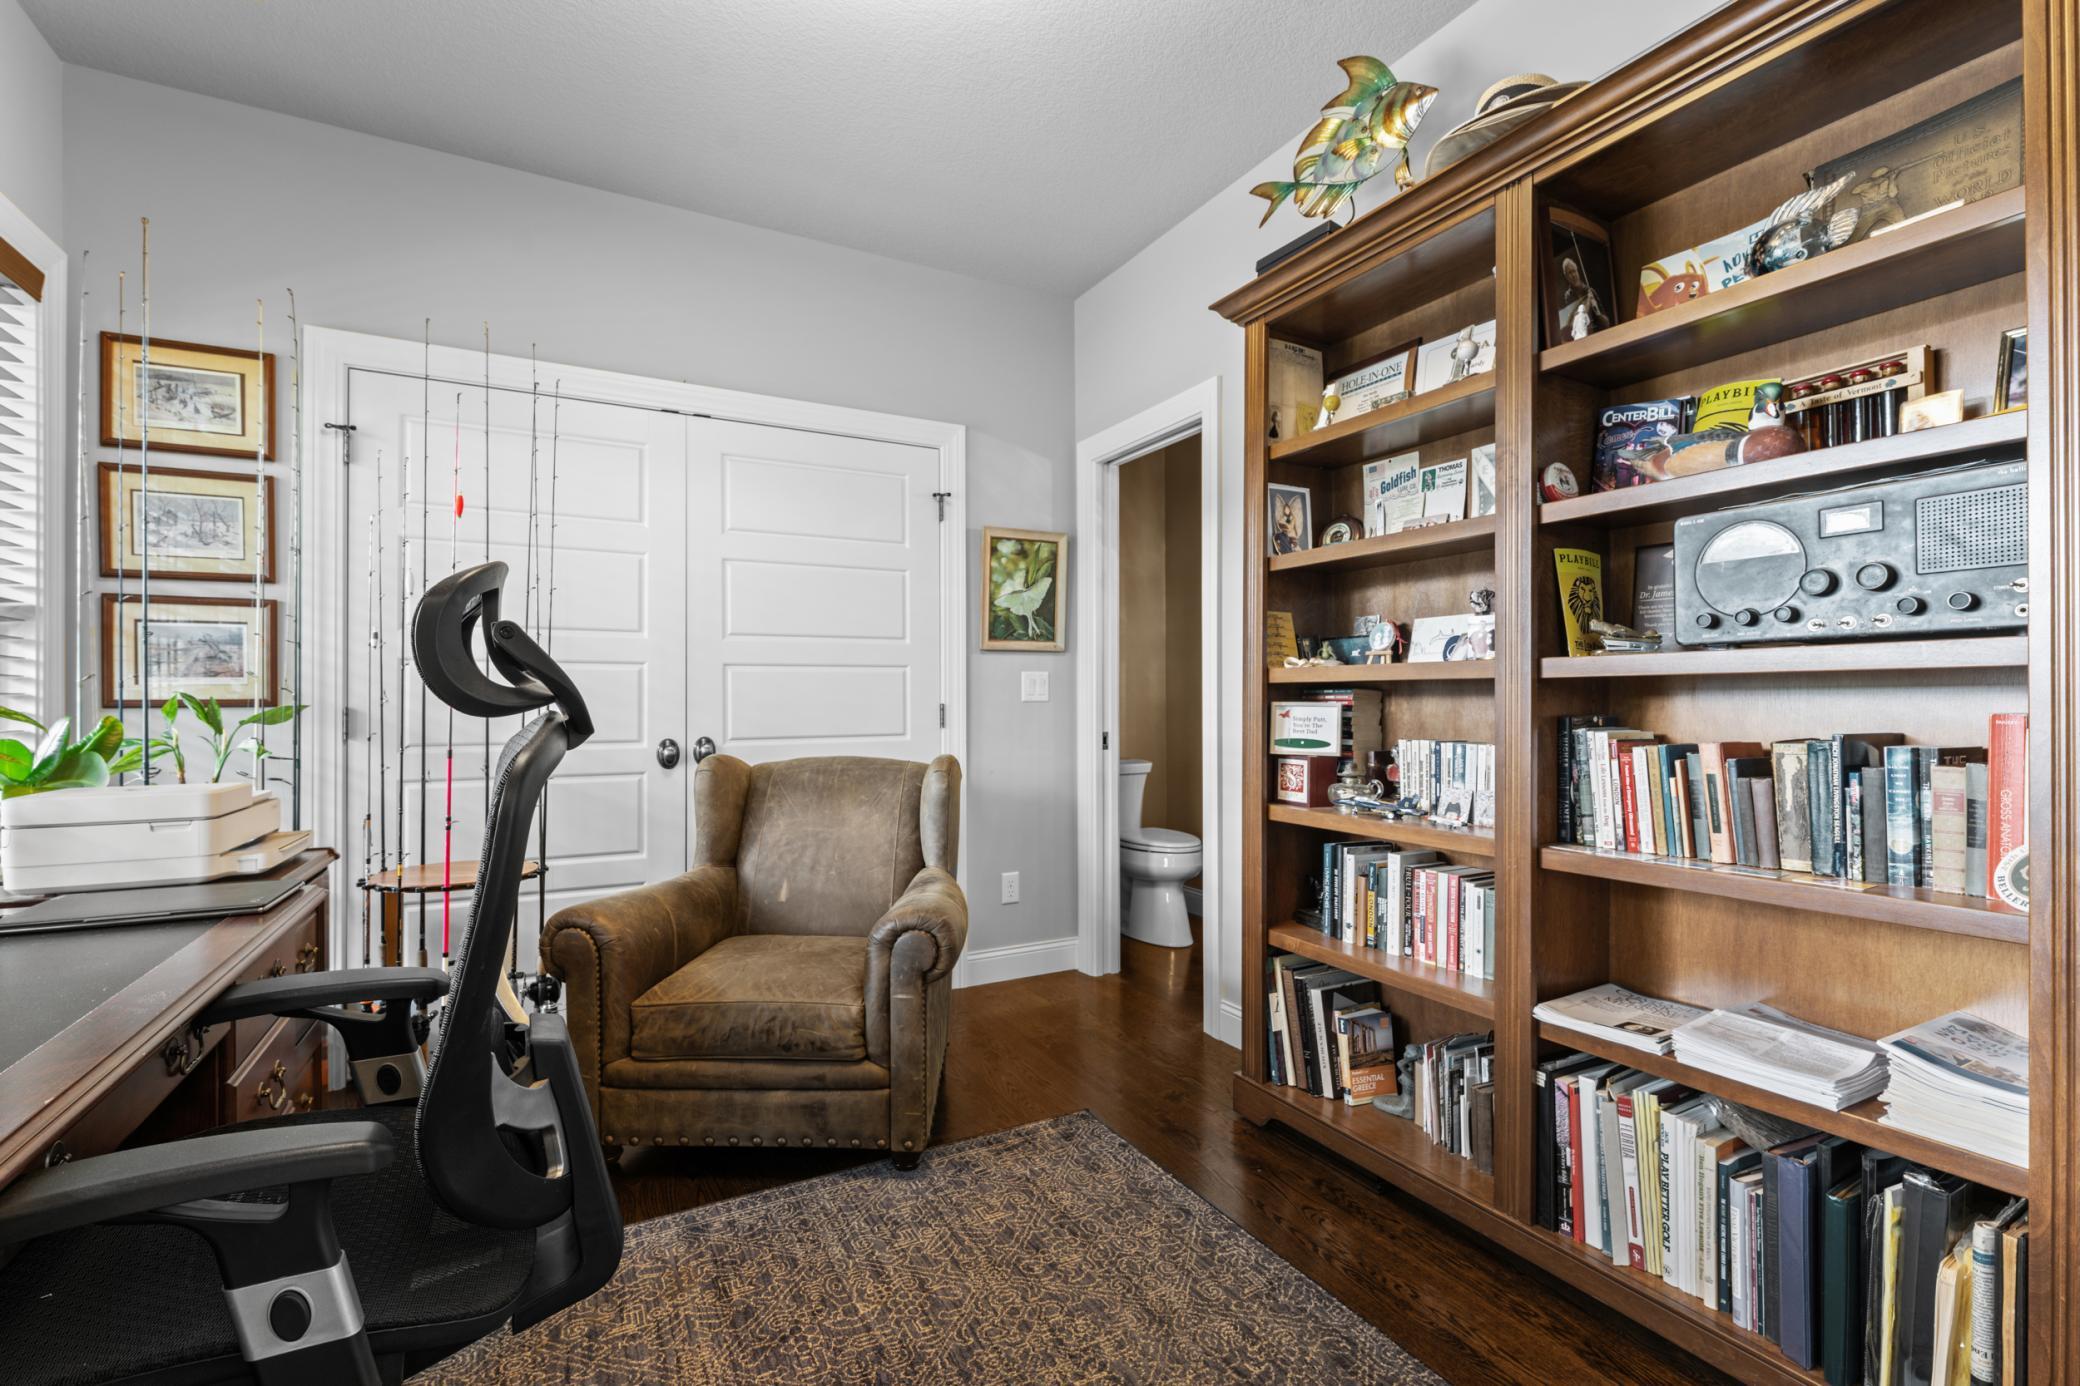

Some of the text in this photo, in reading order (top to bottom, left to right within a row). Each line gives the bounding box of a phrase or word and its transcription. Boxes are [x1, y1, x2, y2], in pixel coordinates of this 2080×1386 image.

[1934, 128, 2011, 168] Official
[1933, 143, 2013, 184] Pictures
[1341, 361, 1403, 391] HOLE-IN-ONE
[1700, 386, 1760, 405] PLAYBI
[1810, 395, 1831, 405] Taste
[1834, 391, 1843, 399] of
[1847, 383, 1882, 395] Vermont
[1380, 465, 1417, 494] Goldfish
[1437, 462, 1463, 472] THOMAS
[1559, 554, 1600, 569] PLAYBILL
[1639, 590, 1674, 600] Dr. Jame
[1832, 758, 1840, 786] JONATHAN
[1612, 779, 1620, 805] LONDON
[1833, 787, 1841, 819] LIVINGSTON
[1999, 791, 2013, 820] GROSS
[1999, 822, 2013, 859] ANATO
[1352, 1073, 1385, 1085] ESSENTIAL
[1353, 1082, 1377, 1092] GREECE
[1620, 1123, 1636, 1159] FLORIDA
[1660, 1151, 1671, 1252] PLAY BETTER GOLF
